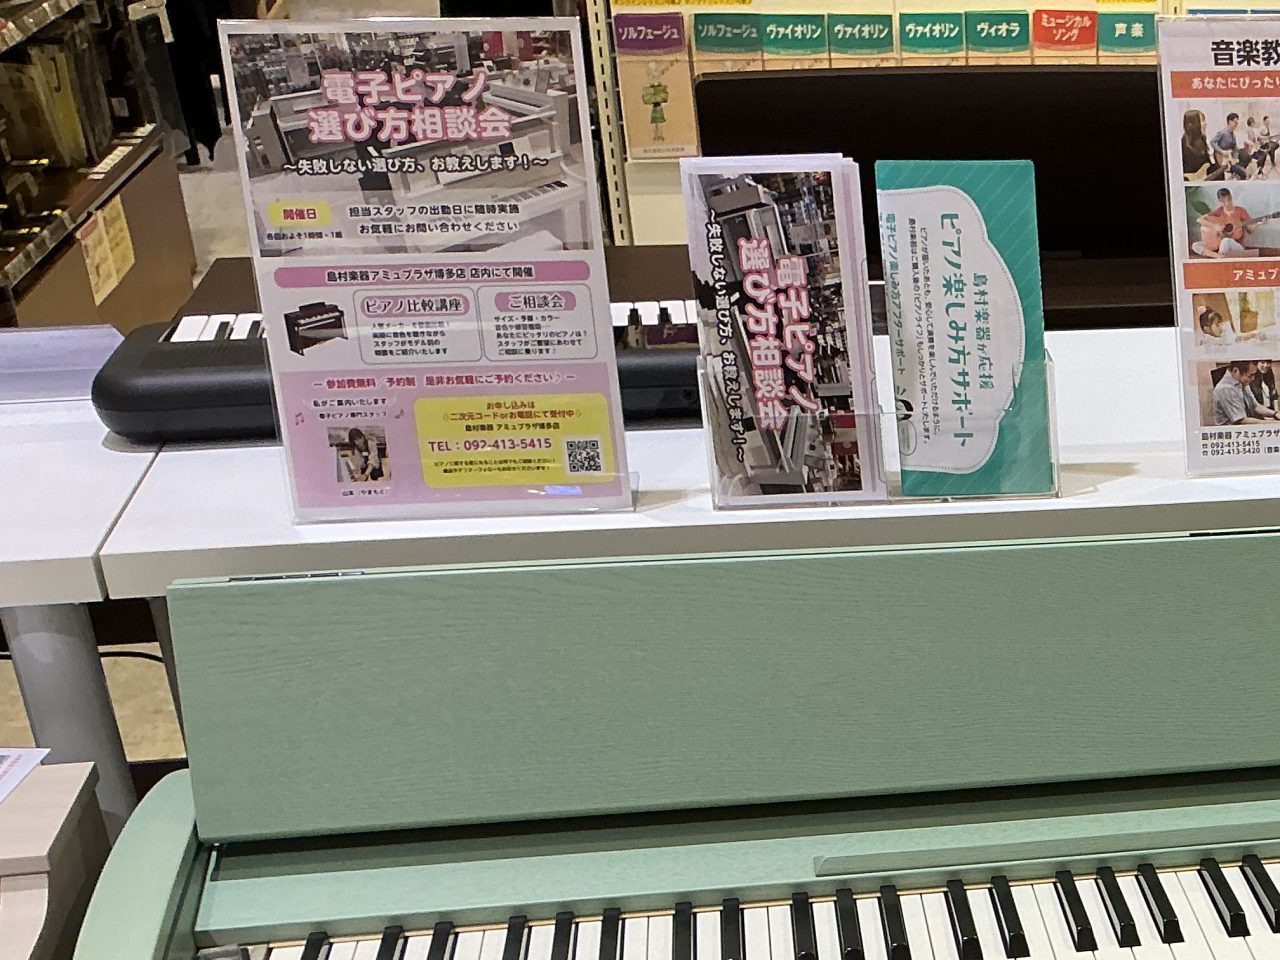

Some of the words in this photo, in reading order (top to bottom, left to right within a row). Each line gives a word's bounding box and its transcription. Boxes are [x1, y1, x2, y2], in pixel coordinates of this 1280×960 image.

[1041, 14, 1093, 28] ミュージカル
[619, 25, 679, 40] ソルフェージュ
[698, 24, 758, 38] ソルフェージュ
[766, 24, 821, 39] ヴァイオリン
[833, 24, 889, 39] ヴァイオリン
[905, 23, 960, 38] ヴァイオリン
[976, 23, 1021, 38] ヴィオラ
[1053, 27, 1079, 41] ソング
[321, 70, 490, 106] 電子ピアノ
[308, 107, 514, 144] 選び方相談会
[283, 208, 318, 220] 開催日
[359, 221, 519, 234] お気軽にお問い合わせください
[326, 268, 467, 283] 島村楽器アミュプラザ博多店
[469, 266, 534, 280] 店内にて開催
[365, 297, 463, 314] ピアノ比較講座
[510, 294, 563, 309] ご相談会
[737, 236, 787, 432] 選び方相談会
[775, 254, 821, 413] 電子ピアノ
[940, 211, 979, 449] ピアノ楽しみ方サポート
[972, 272, 995, 390] 島村楽器が応援
[1201, 431, 1233, 441] 島村楽器
[1210, 440, 1260, 449] 092-413-5415
